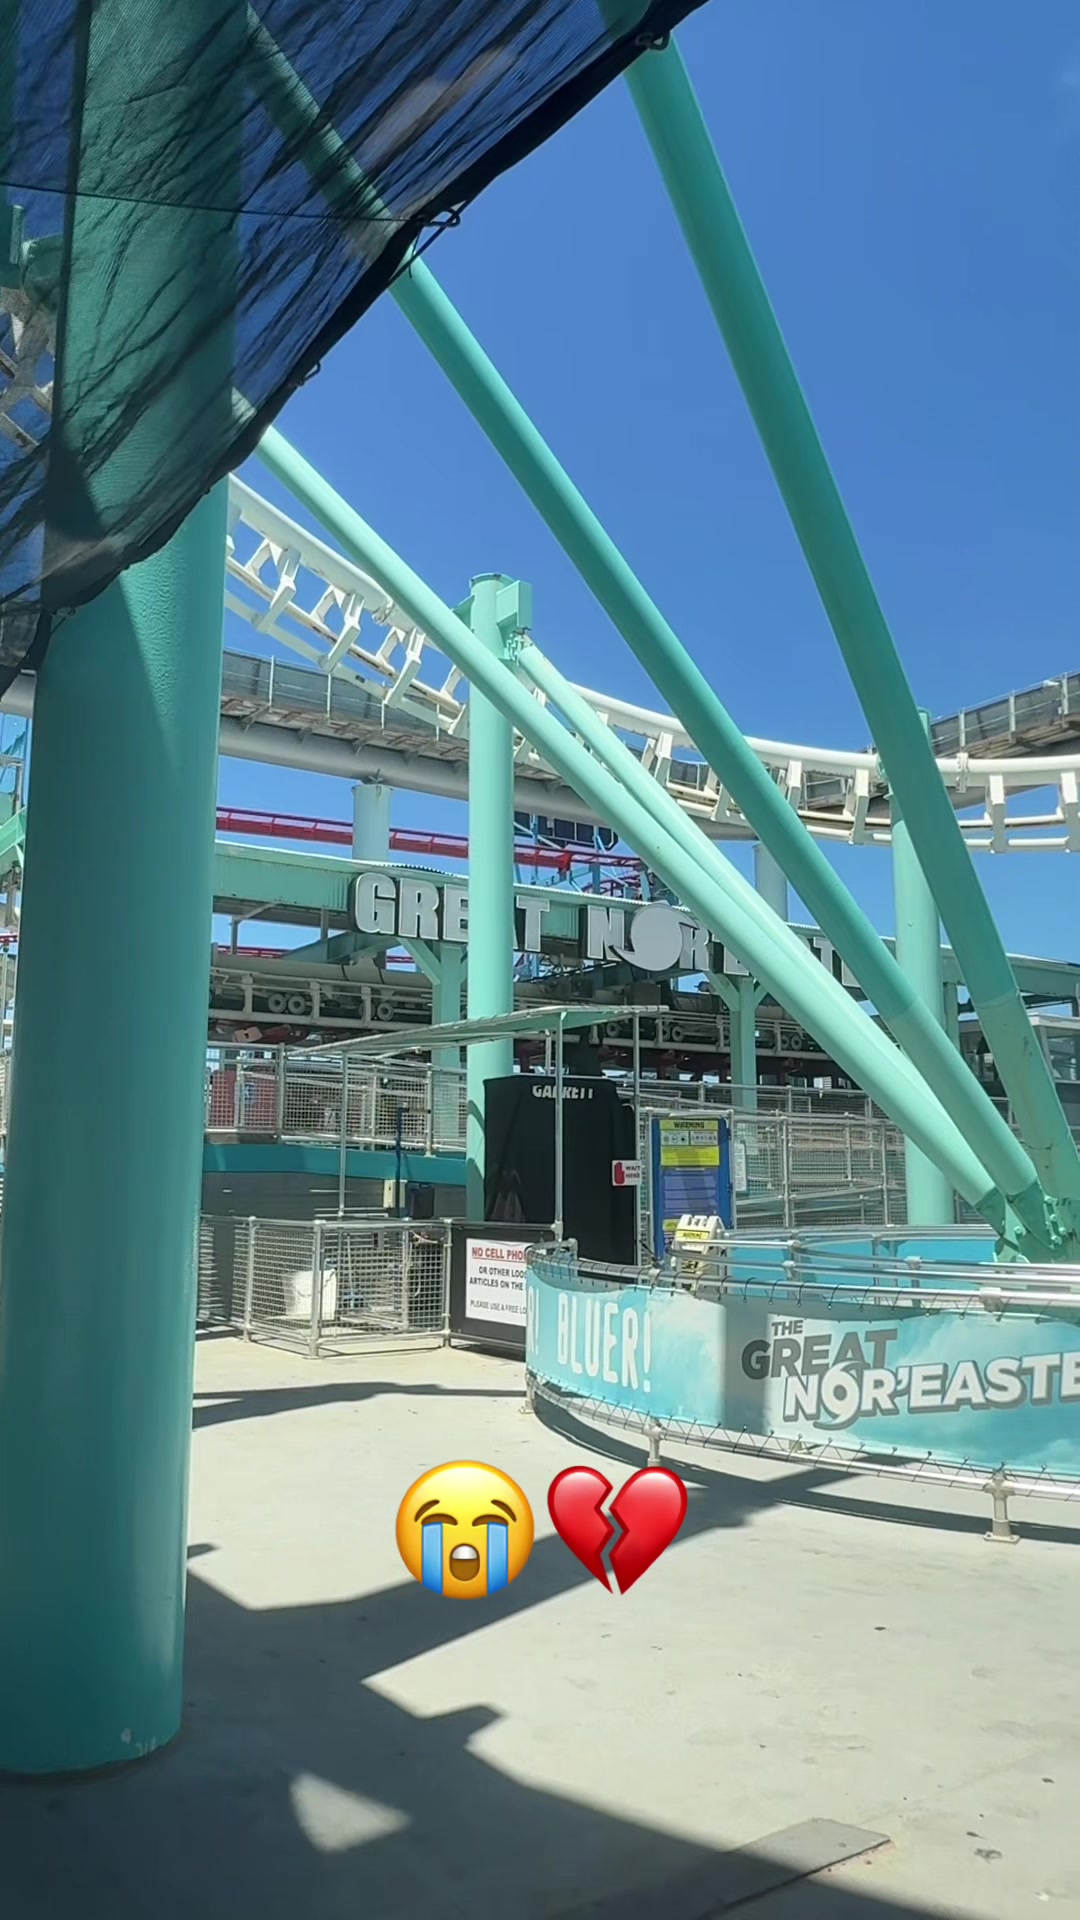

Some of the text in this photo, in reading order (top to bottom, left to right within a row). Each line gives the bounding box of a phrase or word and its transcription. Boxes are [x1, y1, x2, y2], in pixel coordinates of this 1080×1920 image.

[354, 872, 550, 952] GRET
[673, 1121, 705, 1129] WARNING
[472, 1247, 483, 1257] NO
[485, 1248, 505, 1259] CELL
[479, 1266, 488, 1275] OR
[489, 1267, 510, 1277] OTHER
[469, 1277, 523, 1291] ARTICLES ON THE
[470, 1299, 489, 1309] PLEASE
[490, 1303, 500, 1311] USE
[505, 1304, 519, 1313] FREE
[771, 1320, 804, 1336] THE
[557, 1291, 651, 1393] BLUER!
[742, 1328, 898, 1380] GREAT
